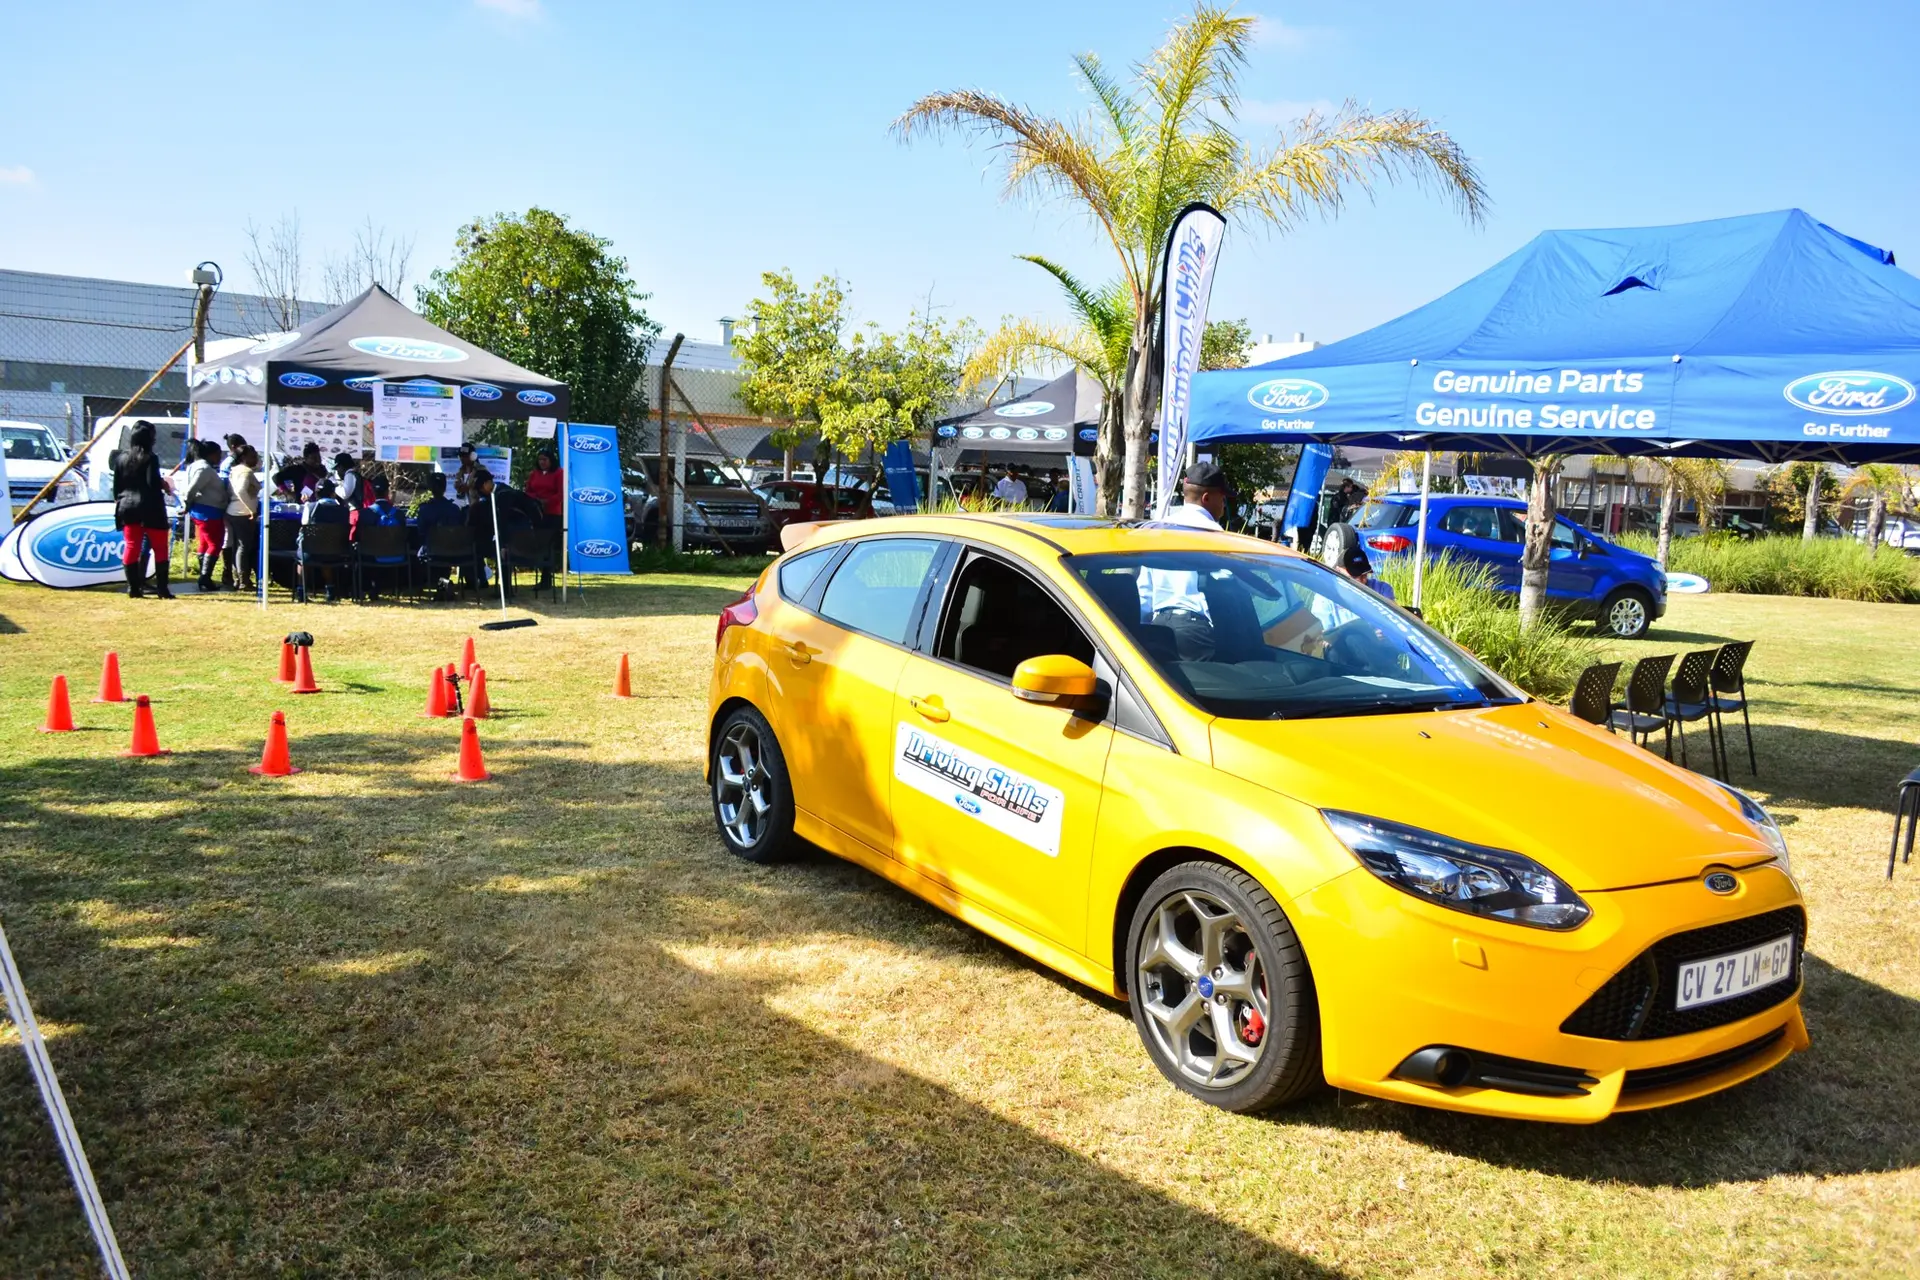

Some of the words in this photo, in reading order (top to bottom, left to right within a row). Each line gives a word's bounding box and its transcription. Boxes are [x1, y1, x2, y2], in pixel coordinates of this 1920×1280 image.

[375, 342, 445, 360] Ford
[287, 375, 318, 388] Ford
[1433, 370, 1552, 394] Genuine
[1557, 369, 1644, 394] Parts
[467, 386, 494, 399] Ford
[523, 392, 548, 404] Ford
[1263, 383, 1313, 407] Ford
[1807, 377, 1889, 408] Ford
[1415, 402, 1532, 428] Genuine
[1539, 403, 1655, 430] Service
[1261, 419, 1276, 430] Go
[1277, 419, 1315, 430] Further
[1803, 422, 1827, 435] Go
[1829, 423, 1891, 438] Further
[574, 436, 603, 450] Ford
[578, 488, 608, 503] Ford
[583, 541, 613, 555] Ford
[906, 732, 983, 793] Driving
[981, 767, 1050, 815] Skills
[979, 790, 1007, 808] FOR
[1712, 875, 1733, 889] Ford
[1682, 965, 1707, 1001] CV
[1713, 958, 1737, 995] 27
[1742, 951, 1762, 988] LM
[1771, 943, 1788, 977] GP
